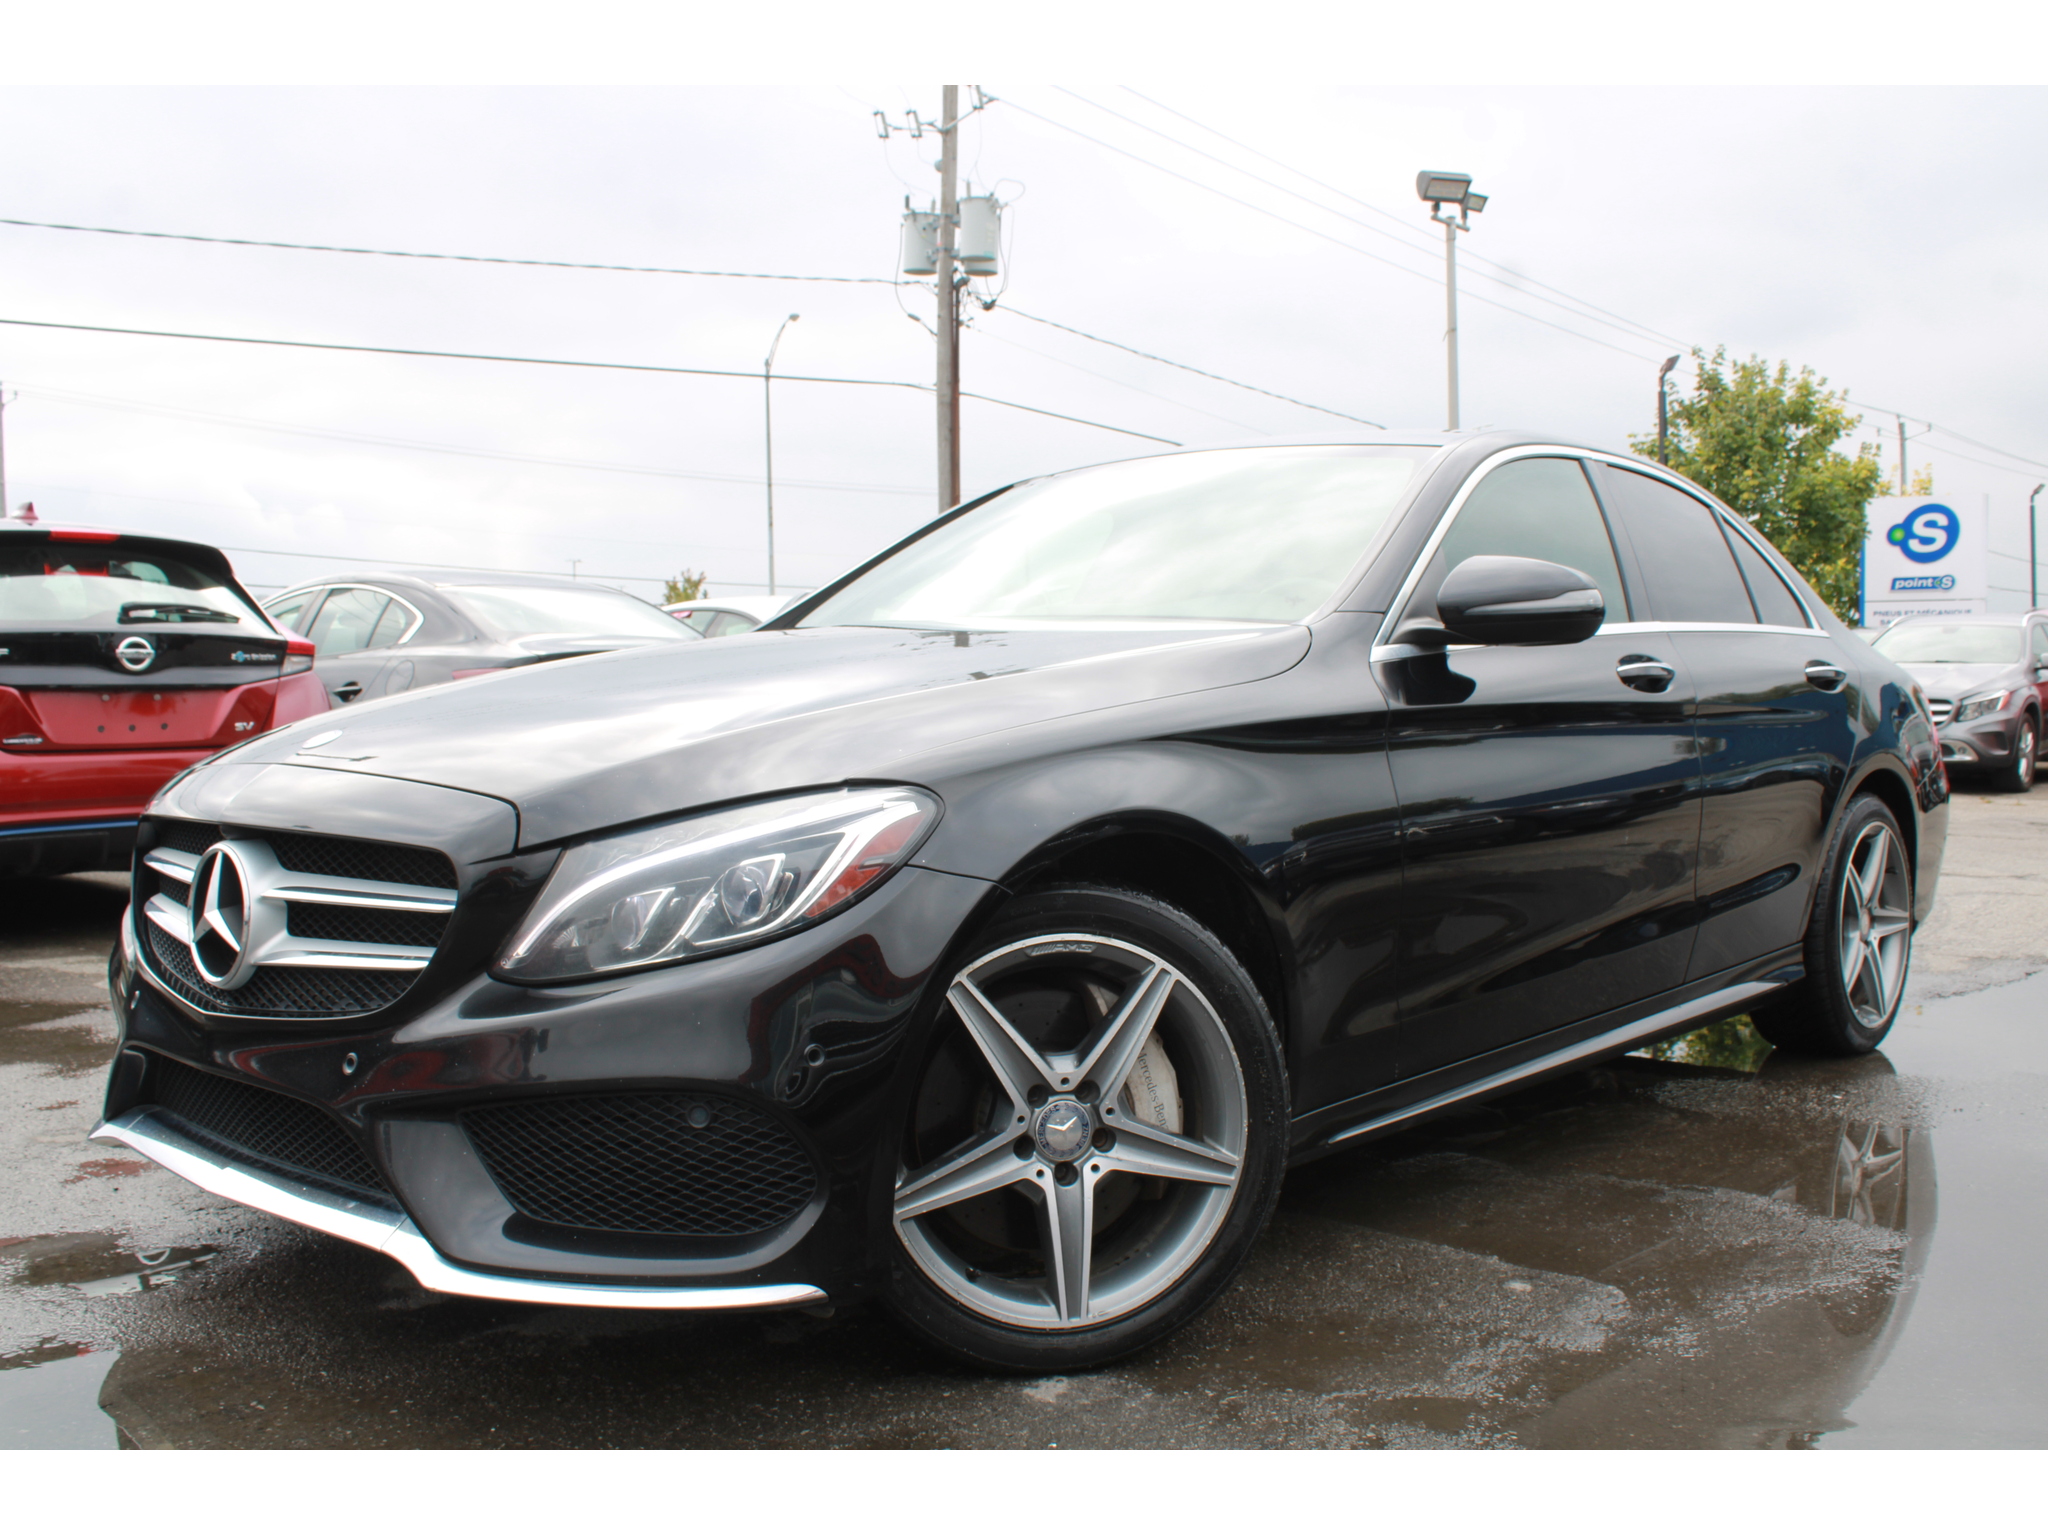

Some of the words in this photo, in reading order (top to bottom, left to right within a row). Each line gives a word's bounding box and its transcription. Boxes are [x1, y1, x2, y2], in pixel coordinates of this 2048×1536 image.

[1908, 512, 1949, 553] S
[1895, 578, 1933, 590] point
[1941, 575, 1953, 589] S
[234, 721, 255, 732] SV
